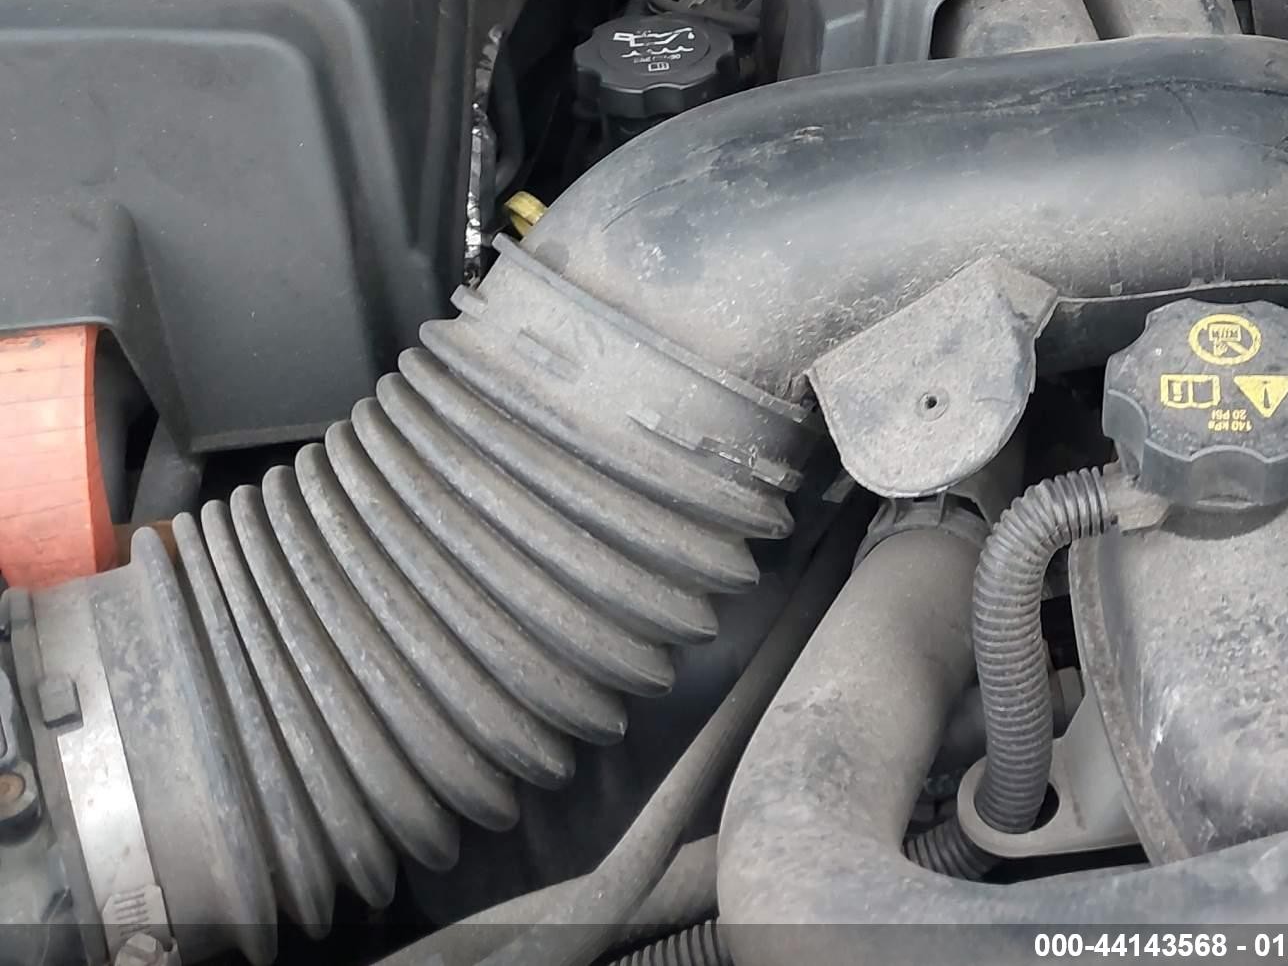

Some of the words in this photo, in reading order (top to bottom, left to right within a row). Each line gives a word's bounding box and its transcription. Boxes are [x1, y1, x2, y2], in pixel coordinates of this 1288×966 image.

[1211, 409, 1231, 420] PSI
[1232, 409, 1247, 420] 20
[1231, 420, 1252, 432] 140
